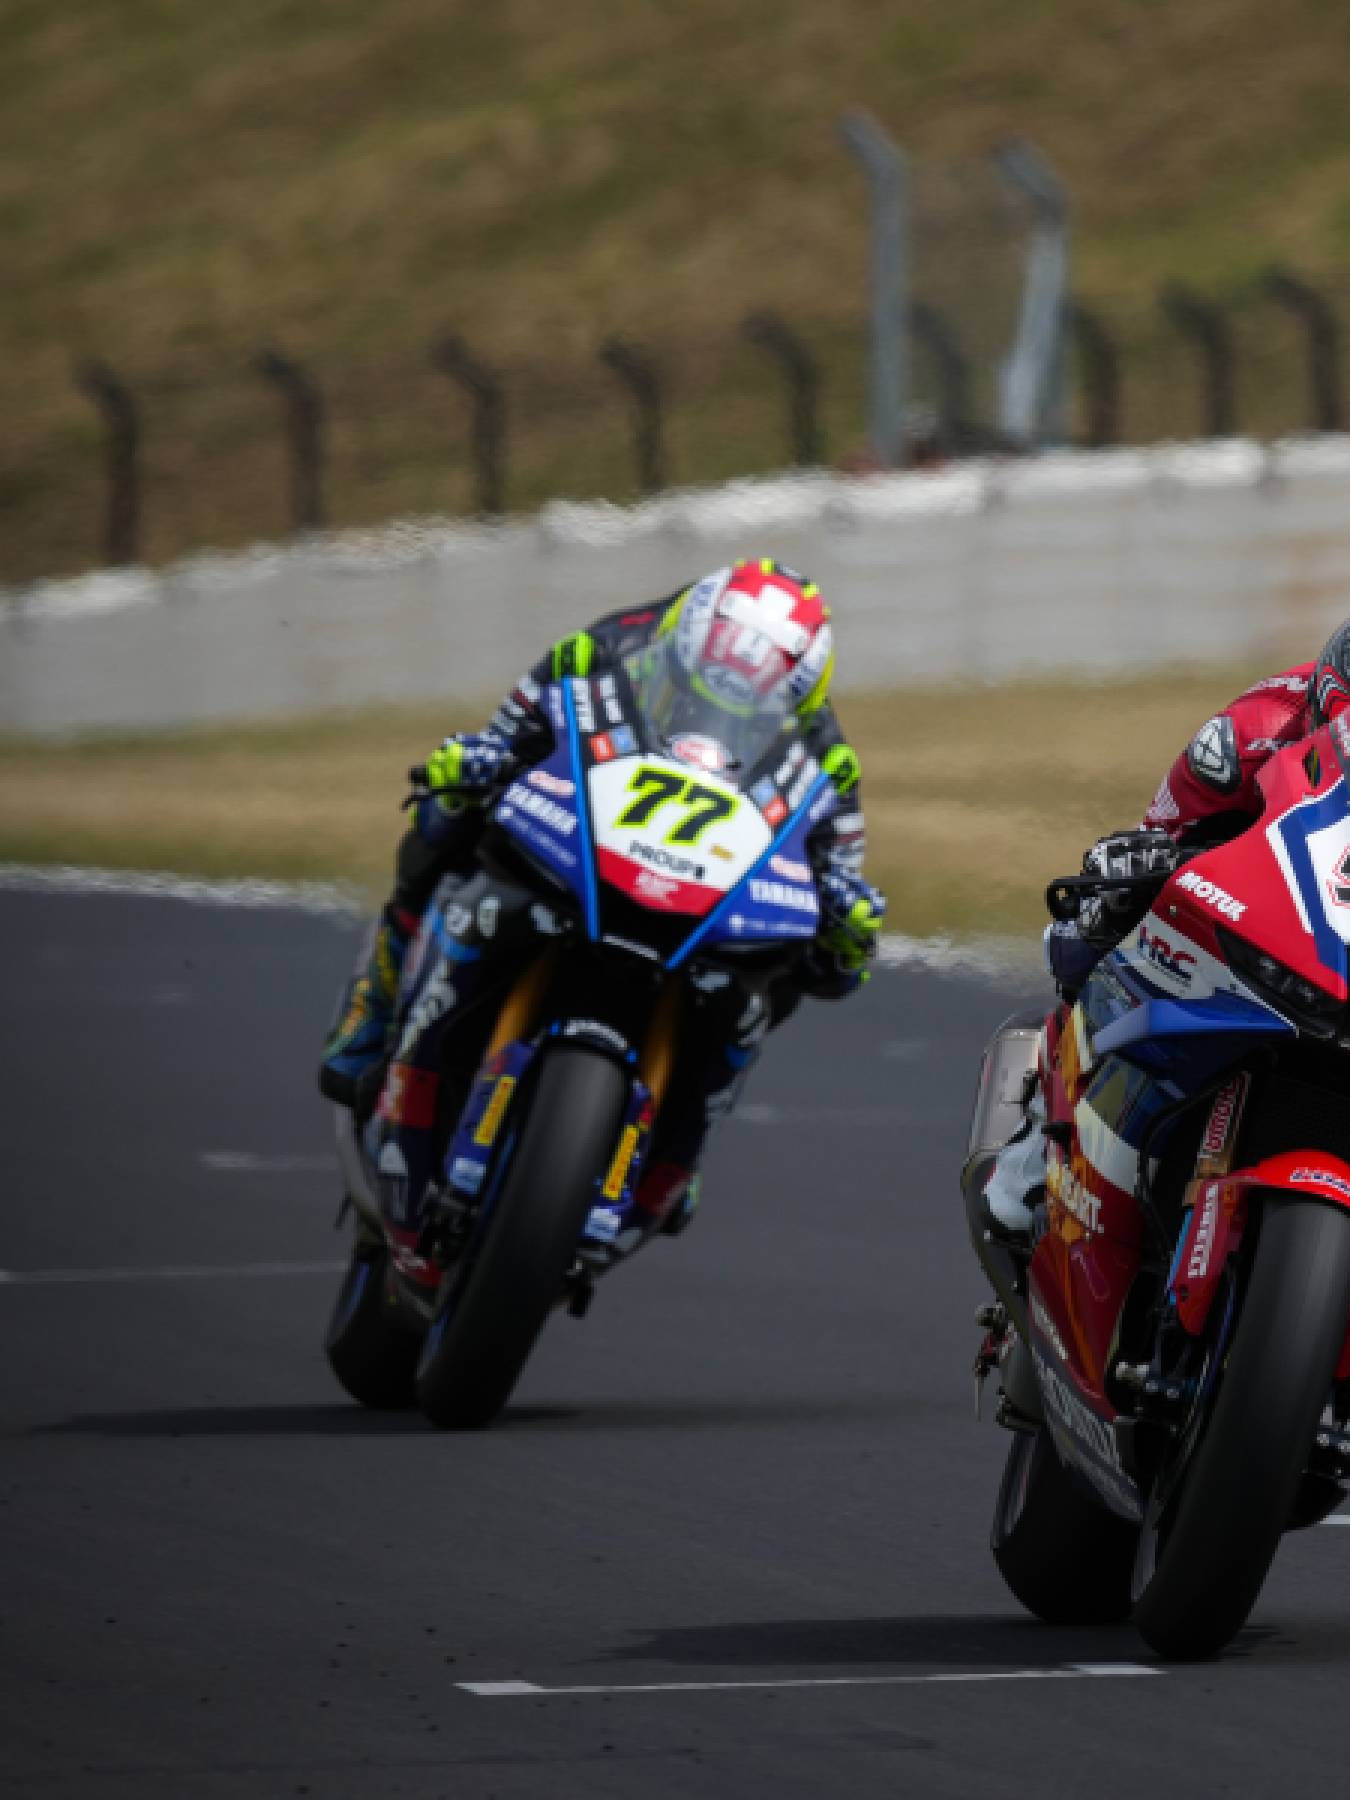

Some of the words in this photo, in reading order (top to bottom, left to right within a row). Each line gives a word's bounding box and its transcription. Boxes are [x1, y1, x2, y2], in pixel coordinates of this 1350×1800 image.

[503, 782, 577, 835] YAMAHA
[614, 764, 738, 847] 77
[748, 879, 819, 913] YAMAHA
[1176, 870, 1247, 921] MOTUL
[1187, 1182, 1219, 1279] PIRELLI
